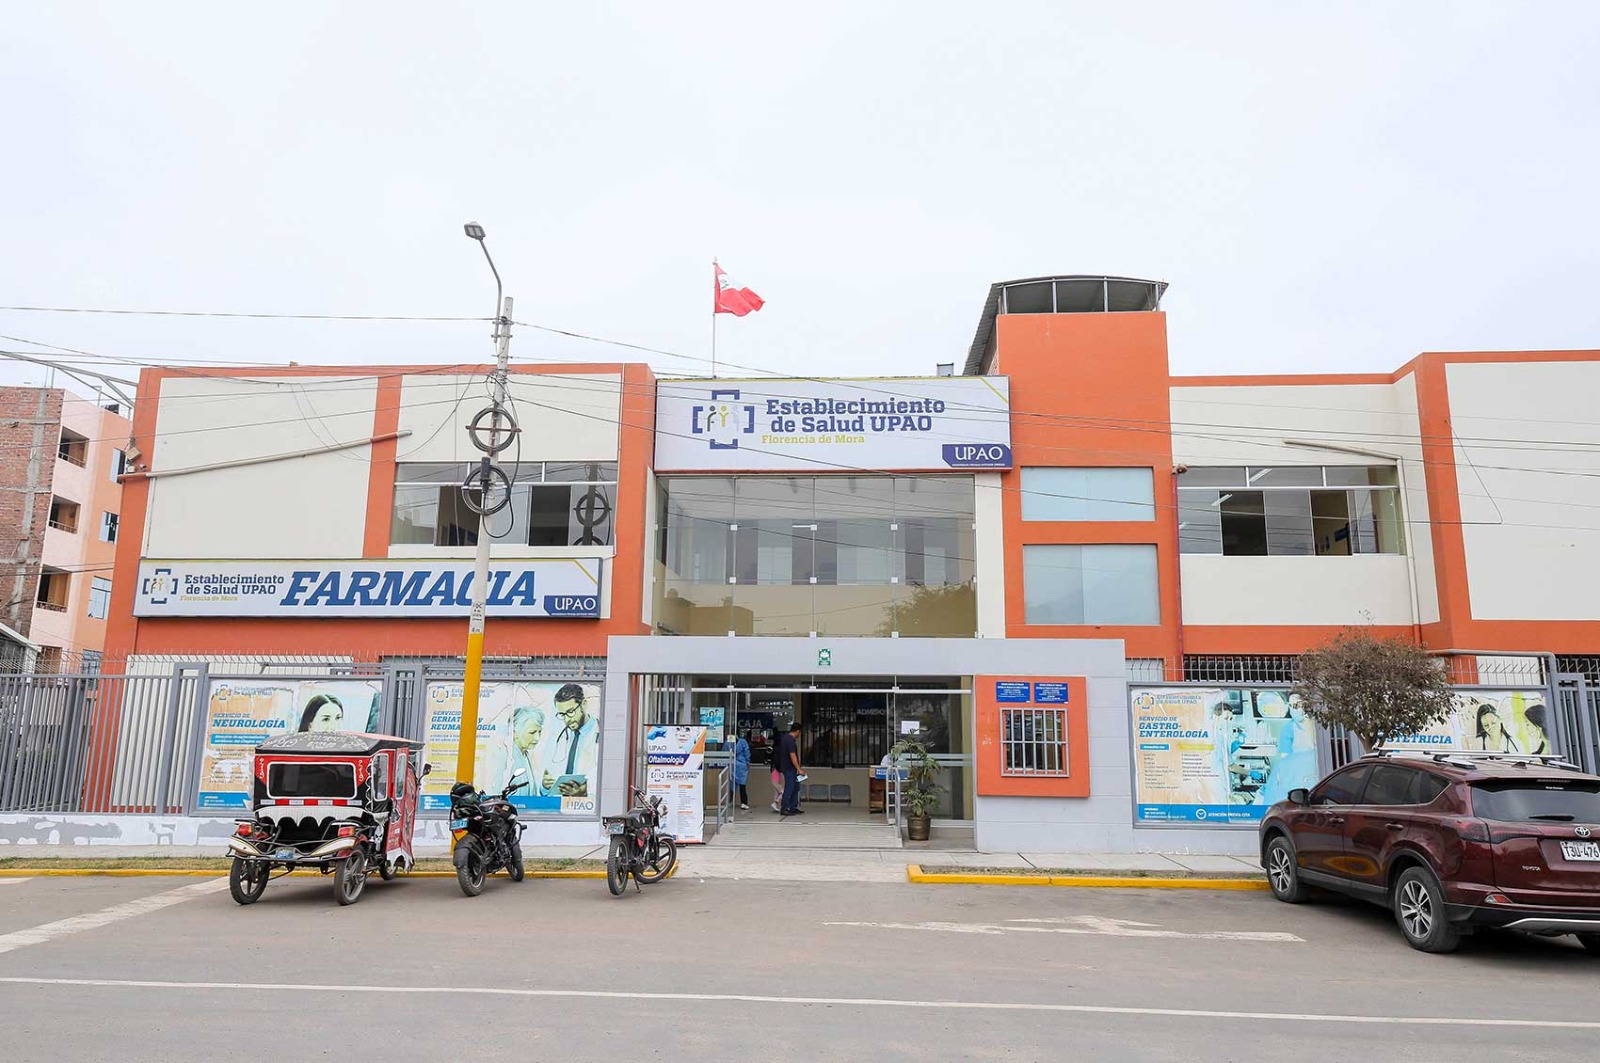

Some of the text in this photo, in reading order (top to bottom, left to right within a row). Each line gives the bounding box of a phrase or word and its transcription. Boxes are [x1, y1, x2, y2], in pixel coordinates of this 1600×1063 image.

[766, 398, 945, 415] Establecimiento
[771, 415, 932, 433] de Salud UPAO
[761, 434, 865, 444] Florencia de Mora
[955, 446, 1003, 461] UPAO
[185, 574, 285, 584] Establecimiento
[186, 584, 276, 594] de Salud UPAO
[554, 597, 597, 611] UPAO
[212, 717, 285, 728] NEUROLOGÍA
[738, 719, 763, 729] CAJA
[1139, 722, 1182, 730] GASTRO-
[1139, 729, 1209, 738] ENTEROLOGÍA
